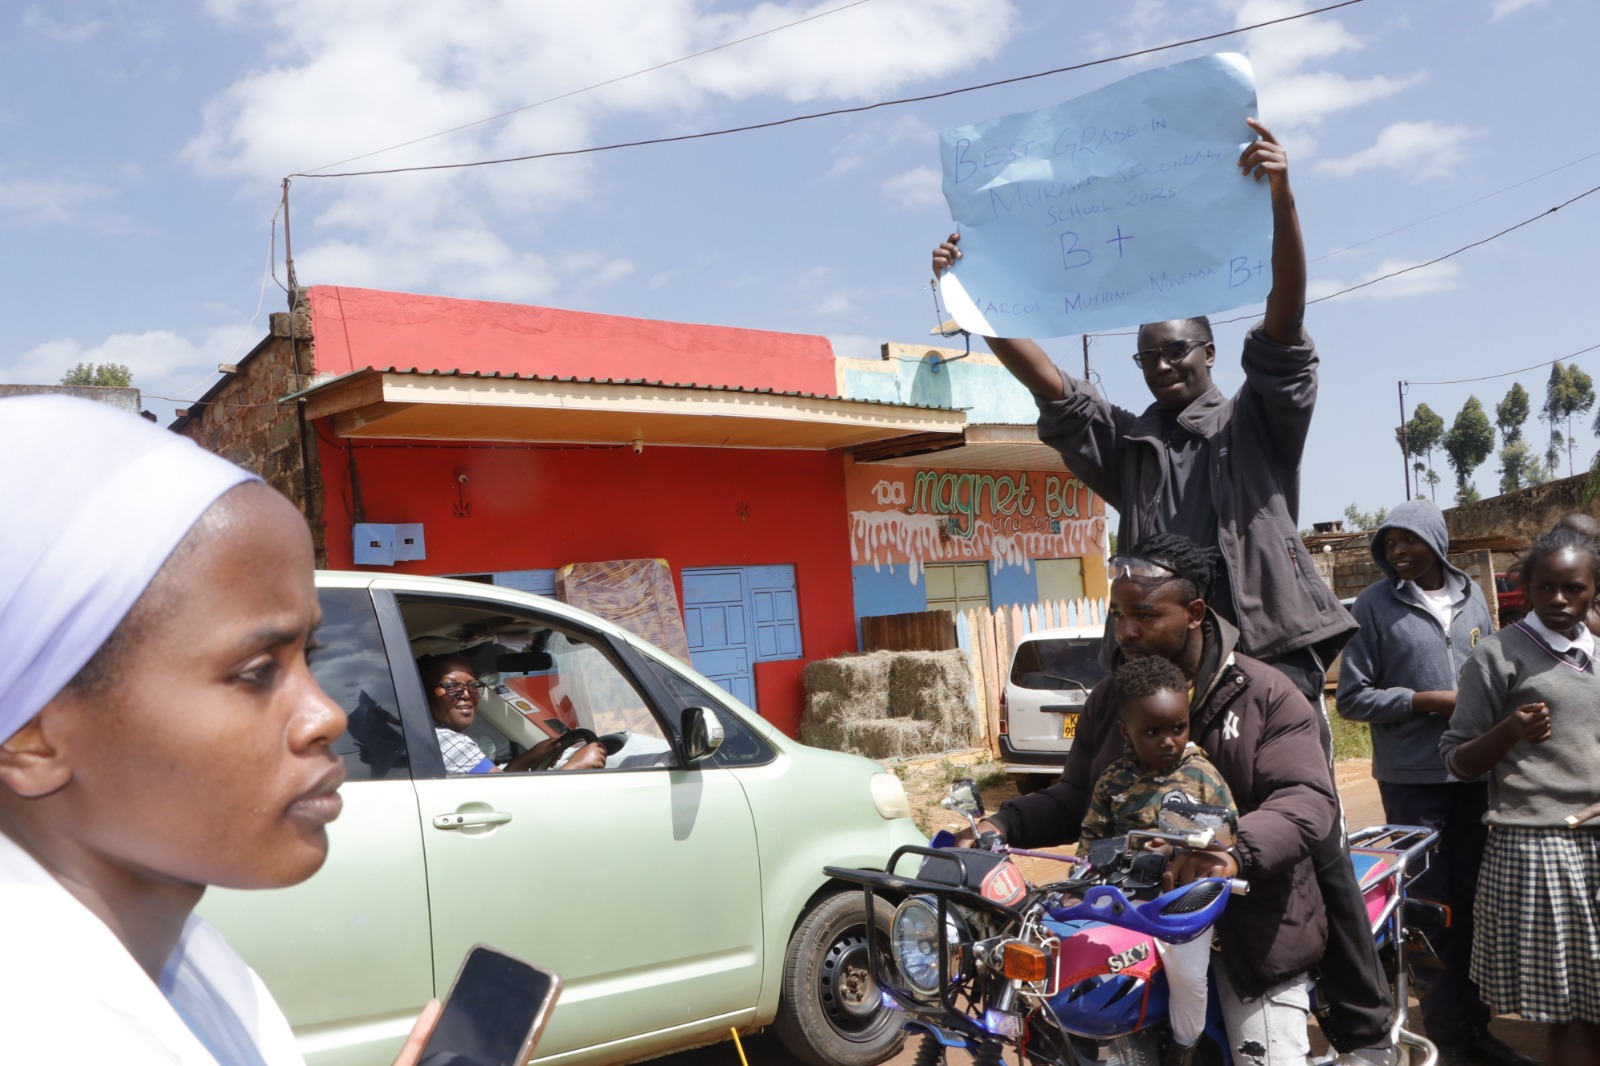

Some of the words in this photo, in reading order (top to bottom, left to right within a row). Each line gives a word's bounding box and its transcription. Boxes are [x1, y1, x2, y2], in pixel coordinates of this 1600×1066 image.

[955, 138, 1034, 184] BEST
[1054, 125, 1141, 160] GRADE
[1151, 117, 1168, 132] IN
[1115, 150, 1221, 183] SECONDARY
[1046, 200, 1115, 227] SCHOOL
[1124, 186, 1178, 208] 2025
[1229, 256, 1265, 289] B+
[1107, 941, 1149, 974] SKY
